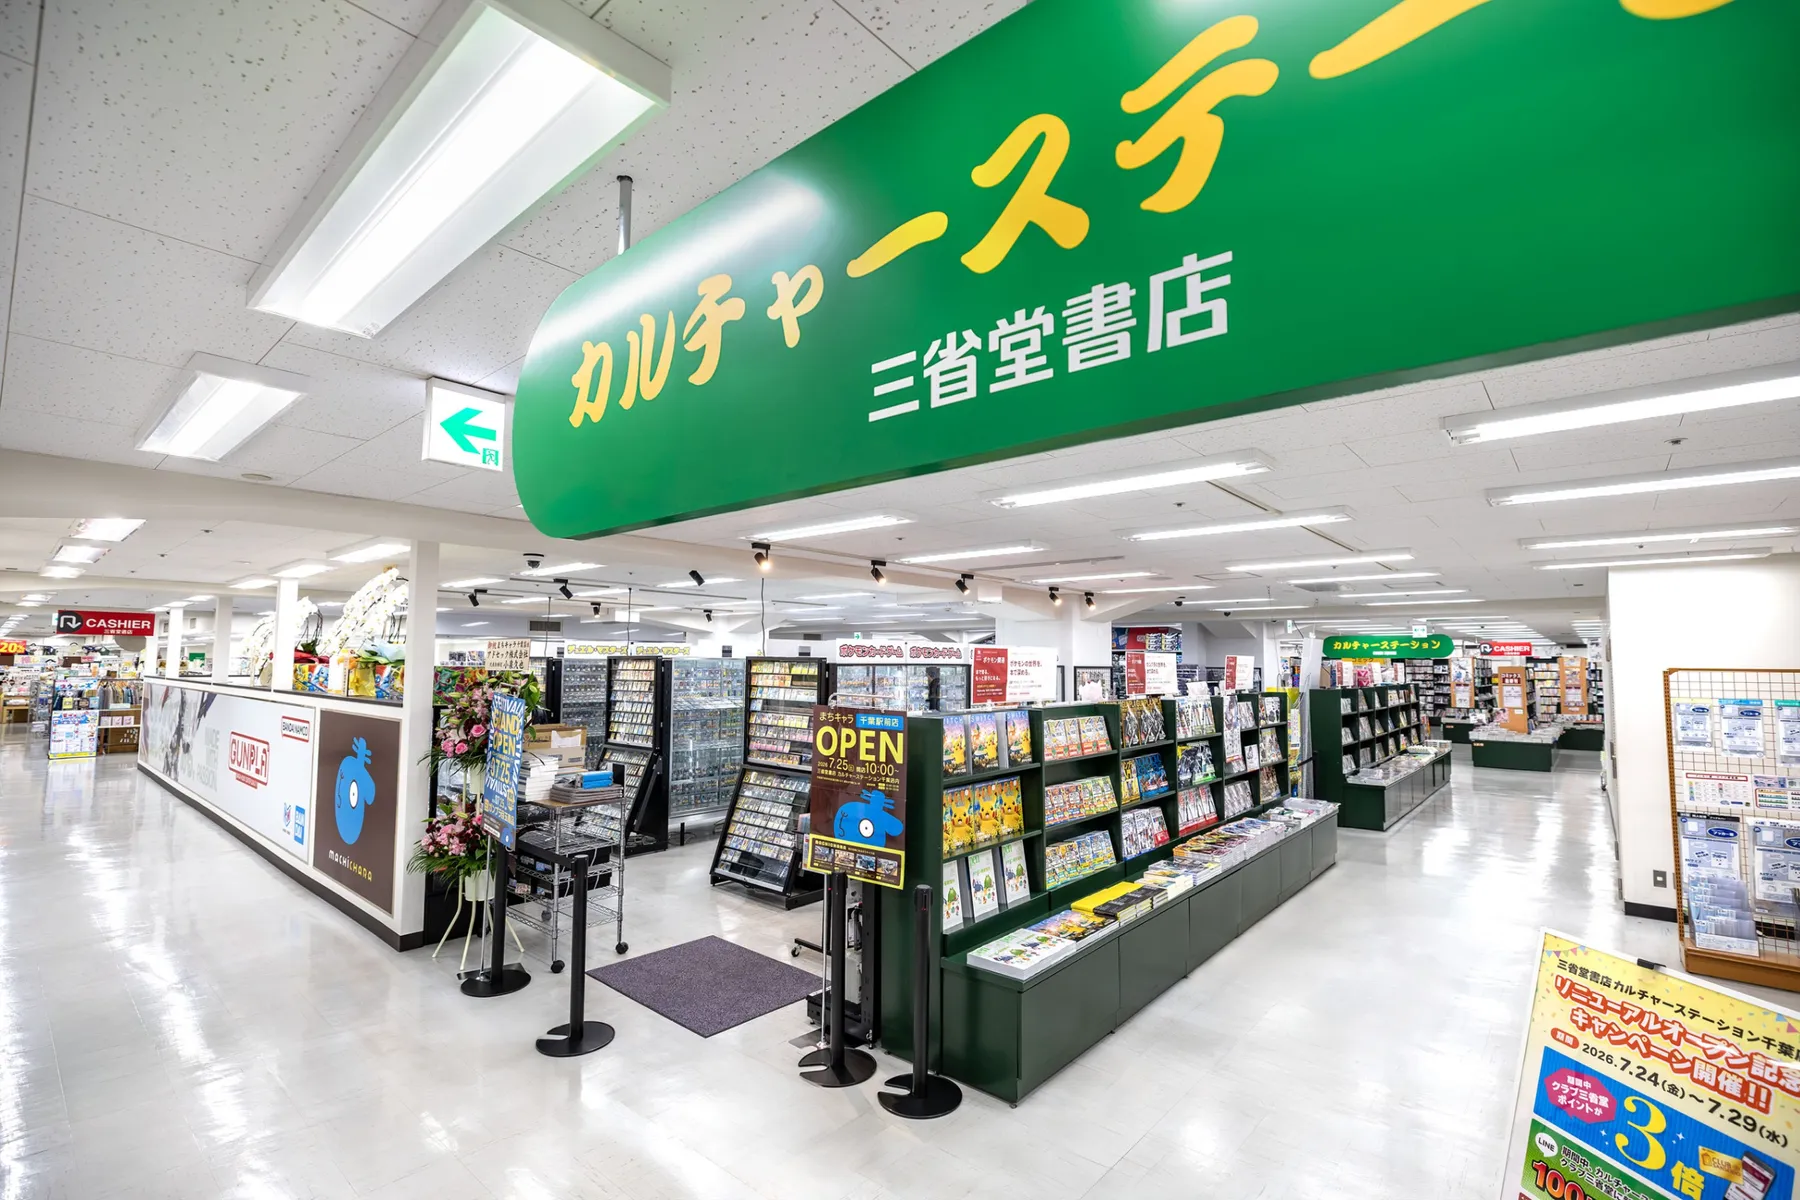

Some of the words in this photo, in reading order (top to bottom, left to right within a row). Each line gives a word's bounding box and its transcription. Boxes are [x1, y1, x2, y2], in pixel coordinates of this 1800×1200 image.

[868, 250, 1233, 423] 三省堂書店
[86, 618, 151, 630] CASHIER
[839, 644, 904, 658] ポケモンカードゲーム
[1333, 640, 1441, 650] カルチャーステーション
[819, 711, 854, 724] まちキャラ
[860, 716, 899, 727] 千葉駅前店
[816, 725, 904, 764] OPEN
[230, 738, 267, 778] GUNPLA
[1555, 1030, 1575, 1047] 期間
[1566, 1075, 1592, 1089] 期間中
[1551, 1081, 1609, 1108] クラブ三省堂
[1557, 1095, 1603, 1116] ポイントが
[1538, 1137, 1555, 1152] LINE
